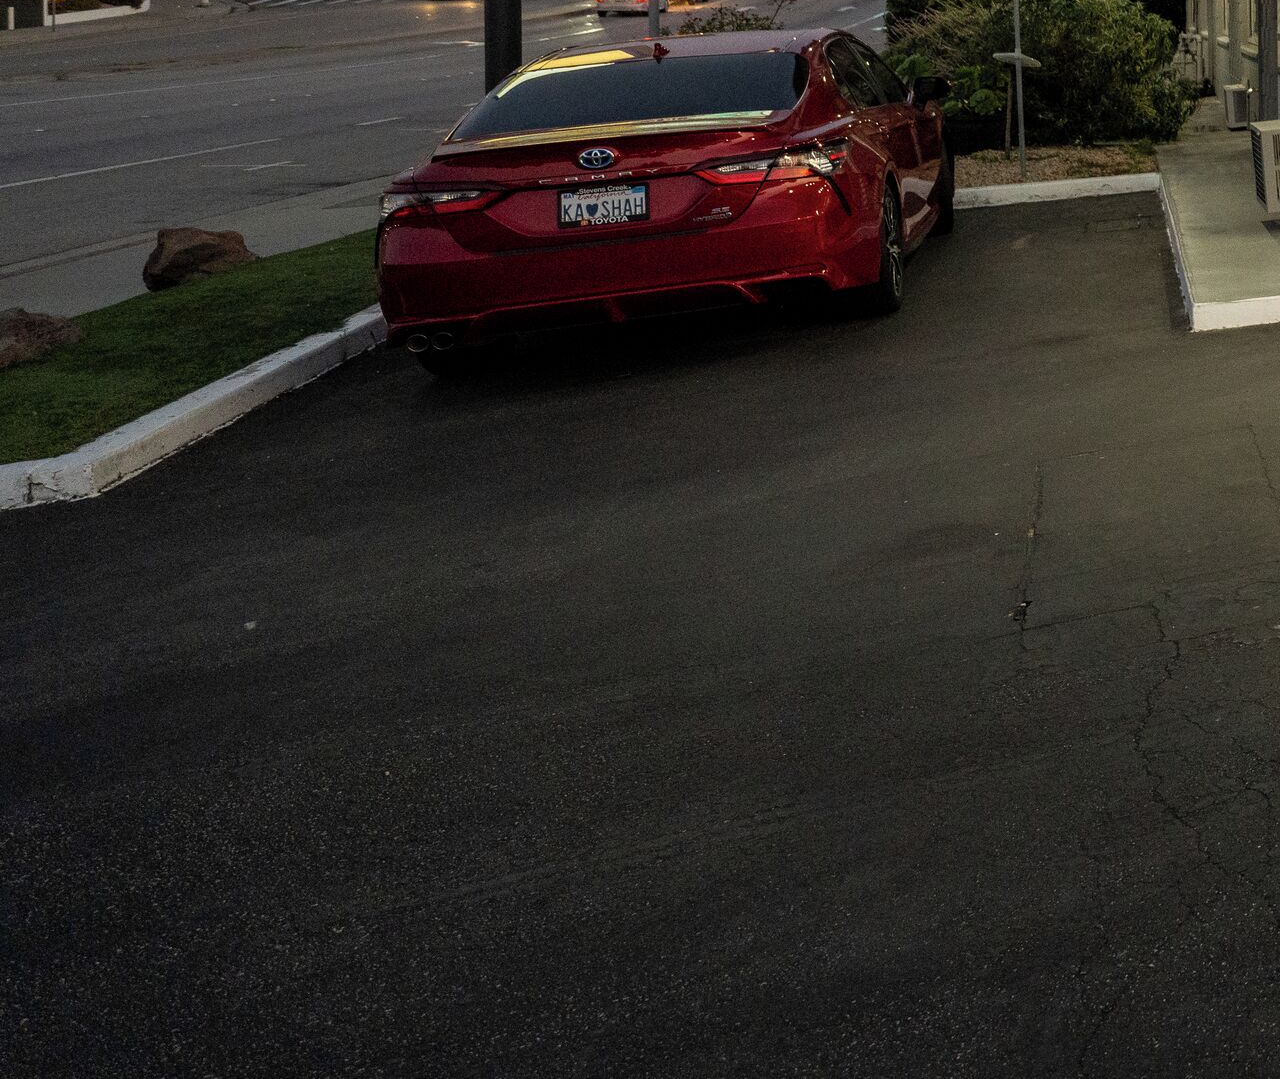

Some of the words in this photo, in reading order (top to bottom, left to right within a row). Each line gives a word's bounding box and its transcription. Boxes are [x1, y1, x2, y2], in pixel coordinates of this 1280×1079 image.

[579, 187, 606, 195] Stevens
[607, 184, 629, 192] Creek
[590, 215, 629, 225] TOYOTA
